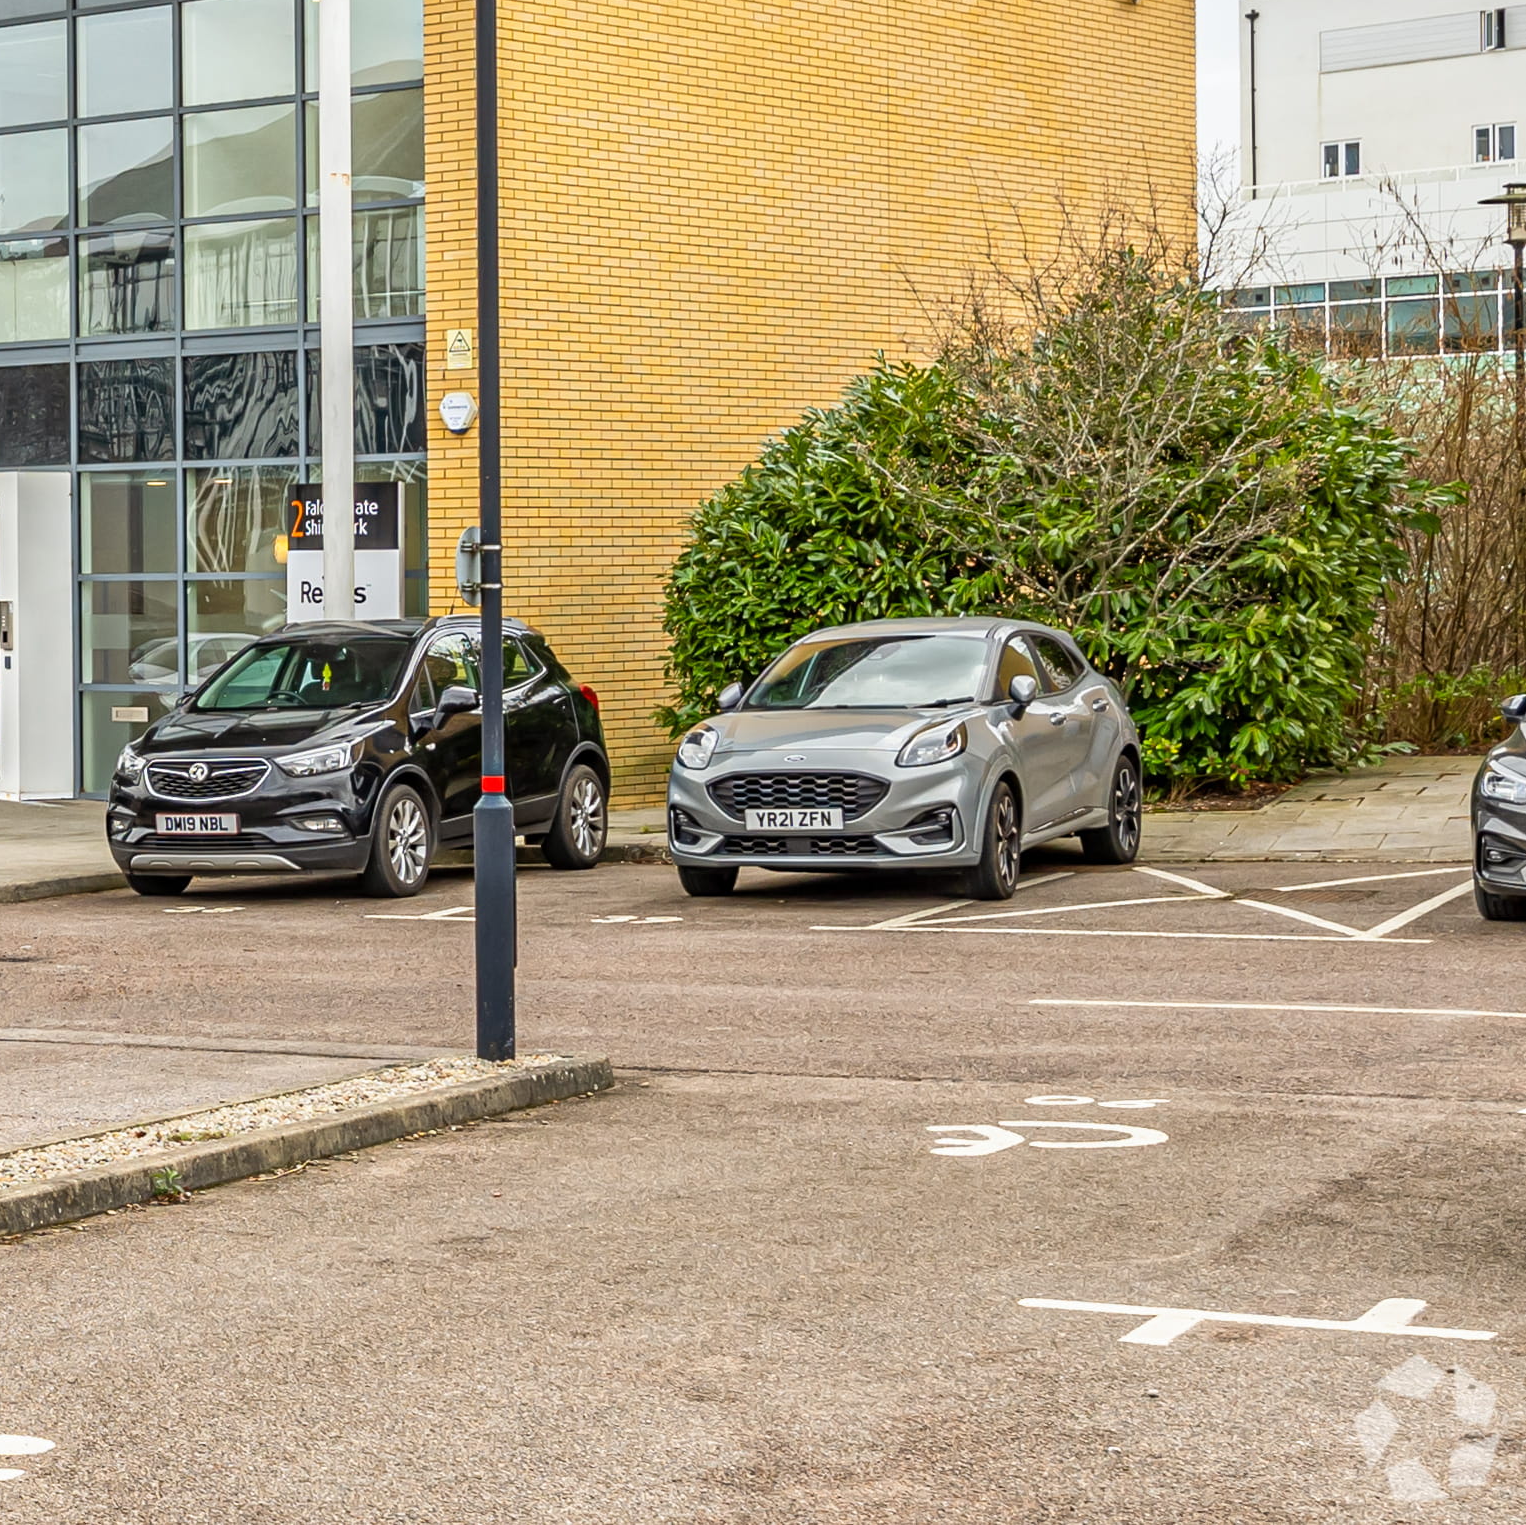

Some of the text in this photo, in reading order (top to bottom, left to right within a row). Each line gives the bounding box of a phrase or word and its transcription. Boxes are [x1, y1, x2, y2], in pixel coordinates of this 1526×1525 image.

[291, 500, 304, 537] 2
[355, 499, 379, 515] ate
[301, 580, 367, 605] Res
[199, 816, 229, 831] NBL
[756, 811, 831, 827] YR21 ZFN
